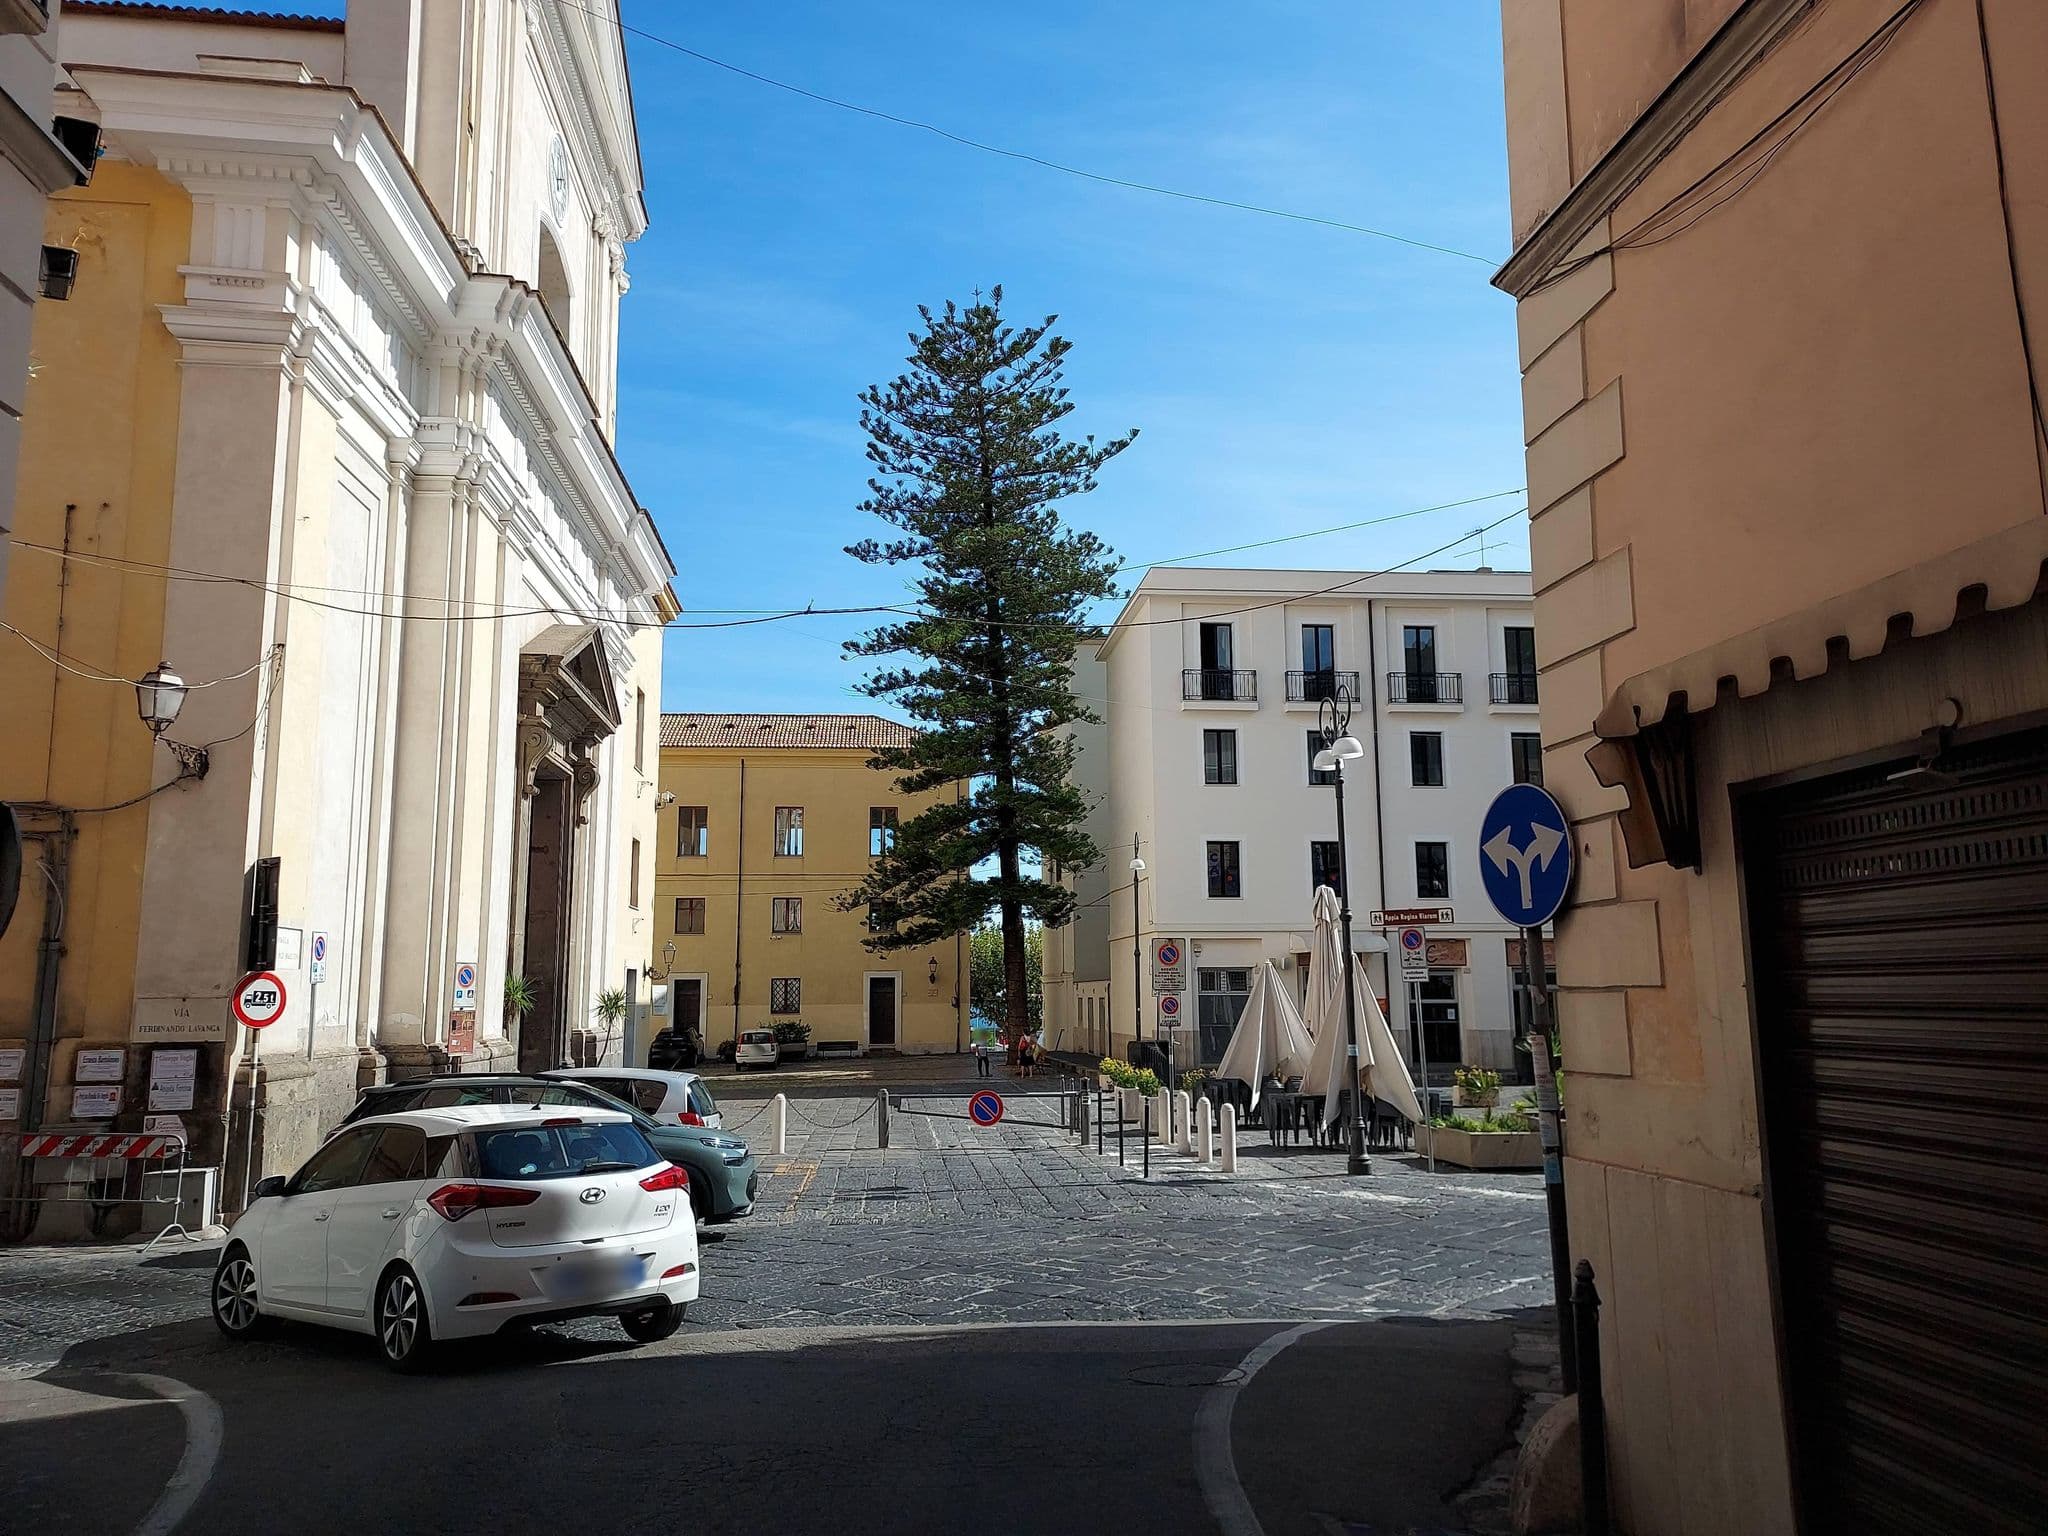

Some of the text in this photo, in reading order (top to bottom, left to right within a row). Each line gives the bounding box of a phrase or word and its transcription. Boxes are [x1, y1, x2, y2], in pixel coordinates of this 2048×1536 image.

[1385, 912, 1437, 922] Appia Regina Viarum
[173, 1007, 190, 1018] VIA
[138, 1024, 221, 1033] FERDINANDO LAVANGA
